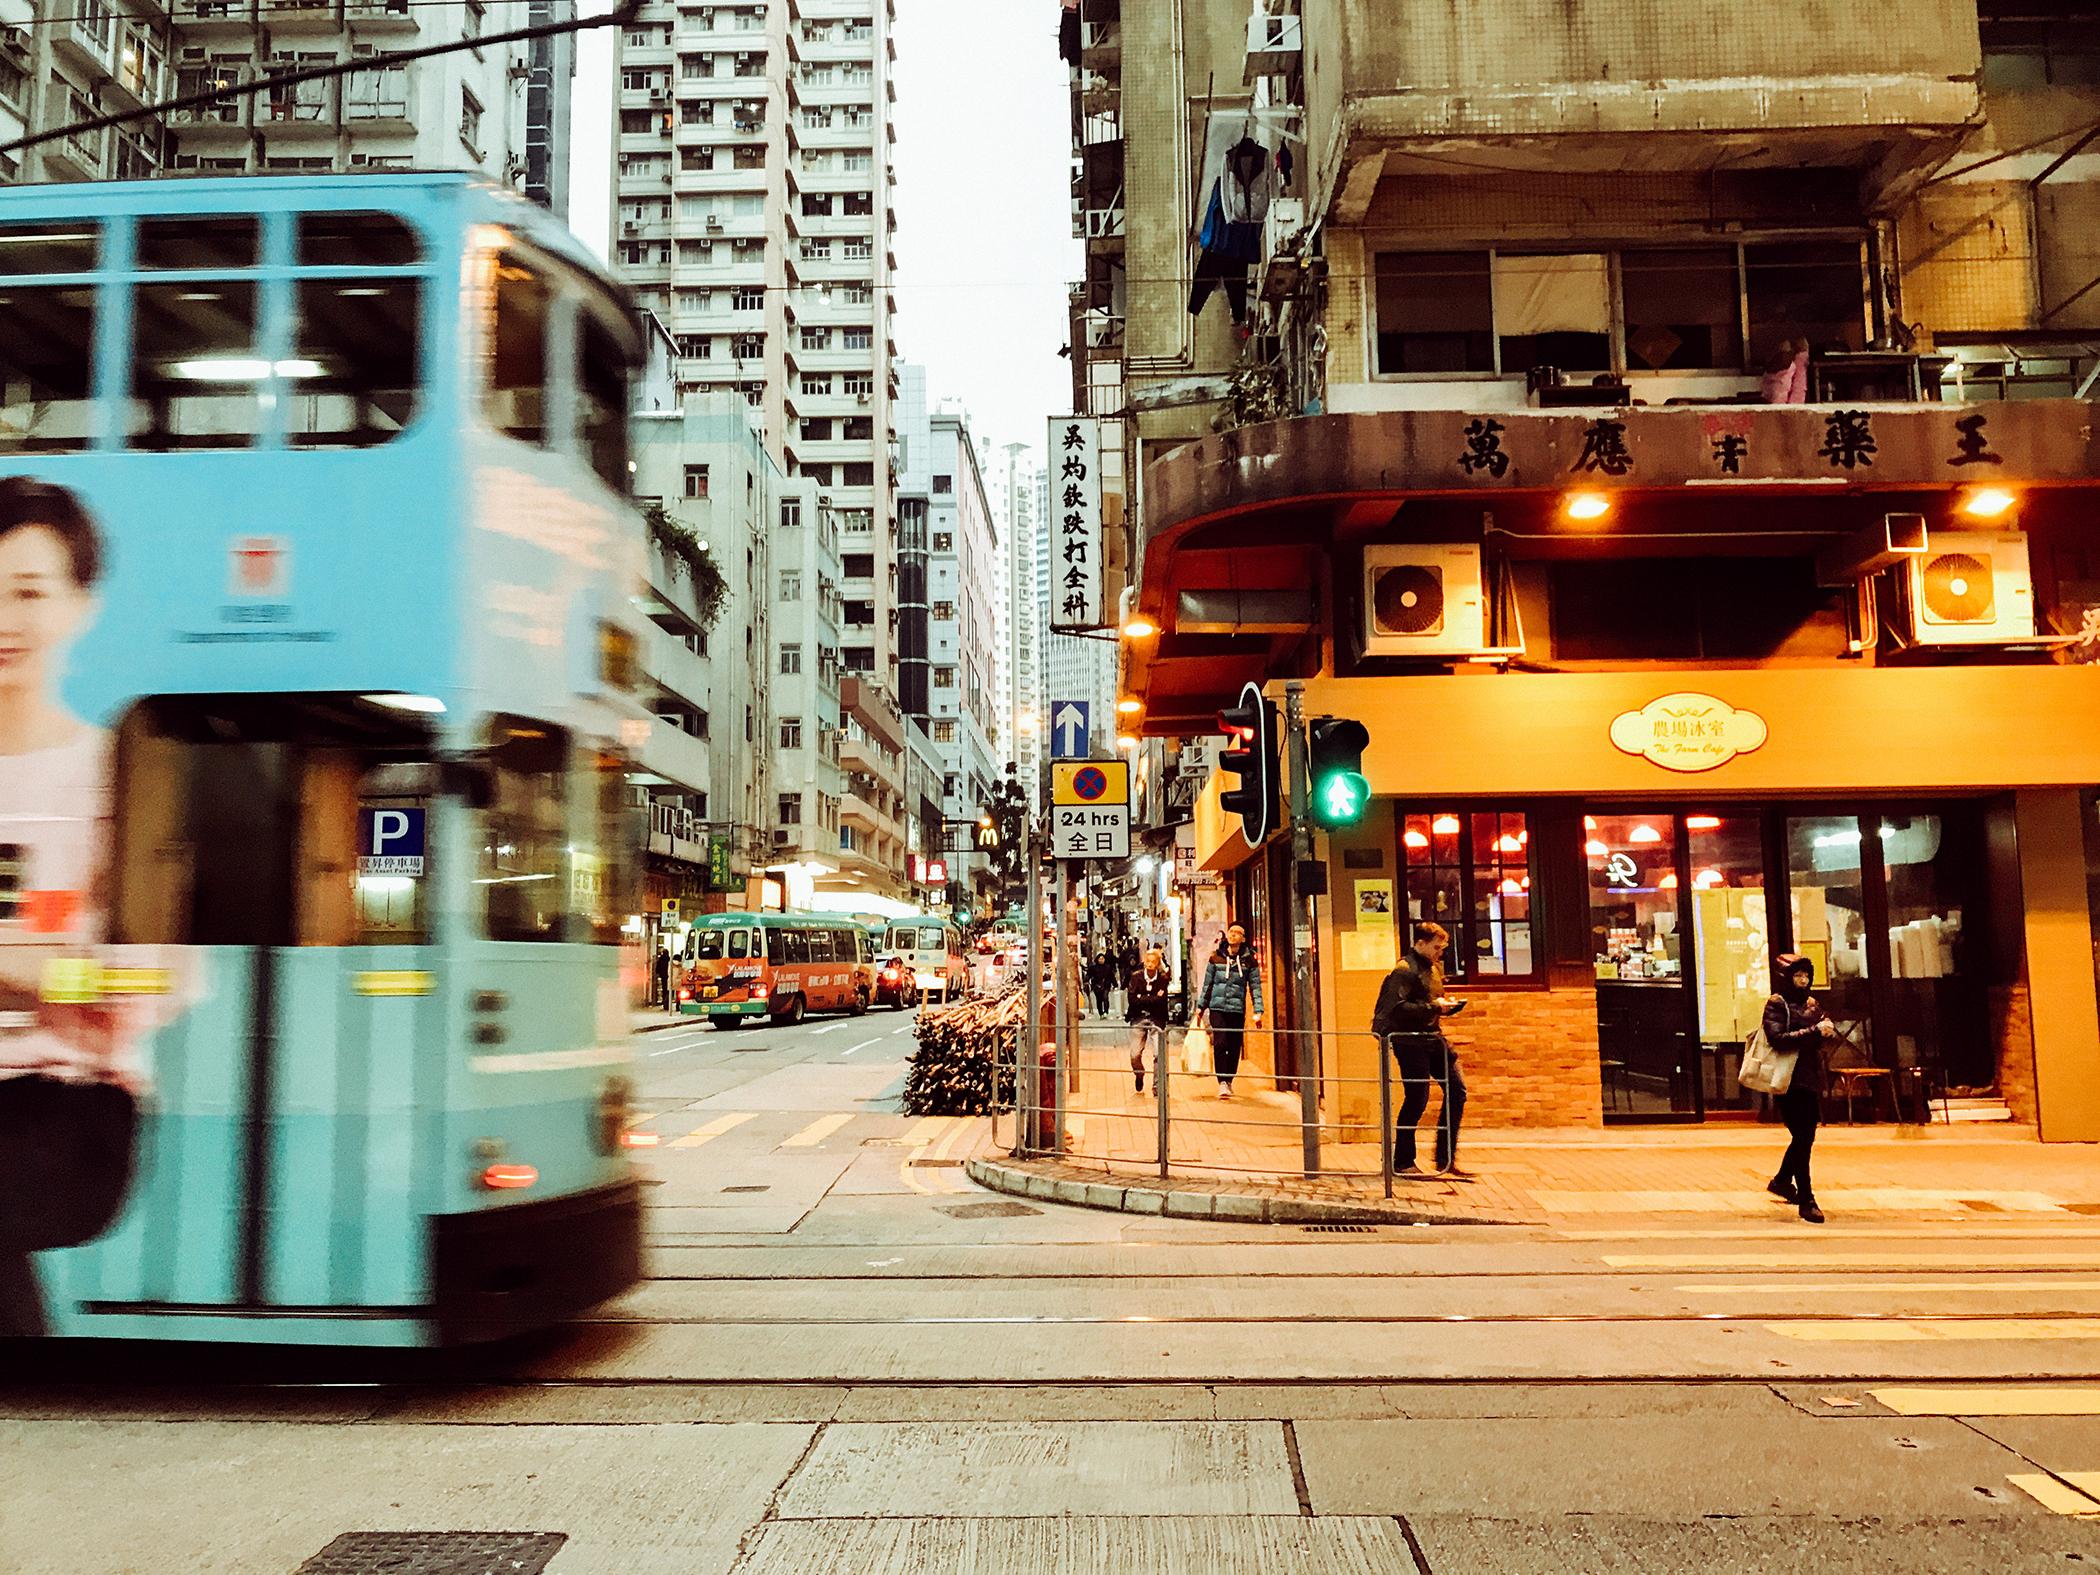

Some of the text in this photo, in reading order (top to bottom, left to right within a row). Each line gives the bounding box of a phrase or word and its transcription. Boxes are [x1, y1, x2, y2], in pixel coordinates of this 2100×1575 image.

[1653, 720, 1725, 737] 農場冰室
[1653, 743, 1669, 753] The
[1673, 743, 1699, 754] Farm
[1062, 811, 1120, 826] 24 hrs
[373, 811, 409, 855] P
[1068, 831, 1112, 852] 全日
